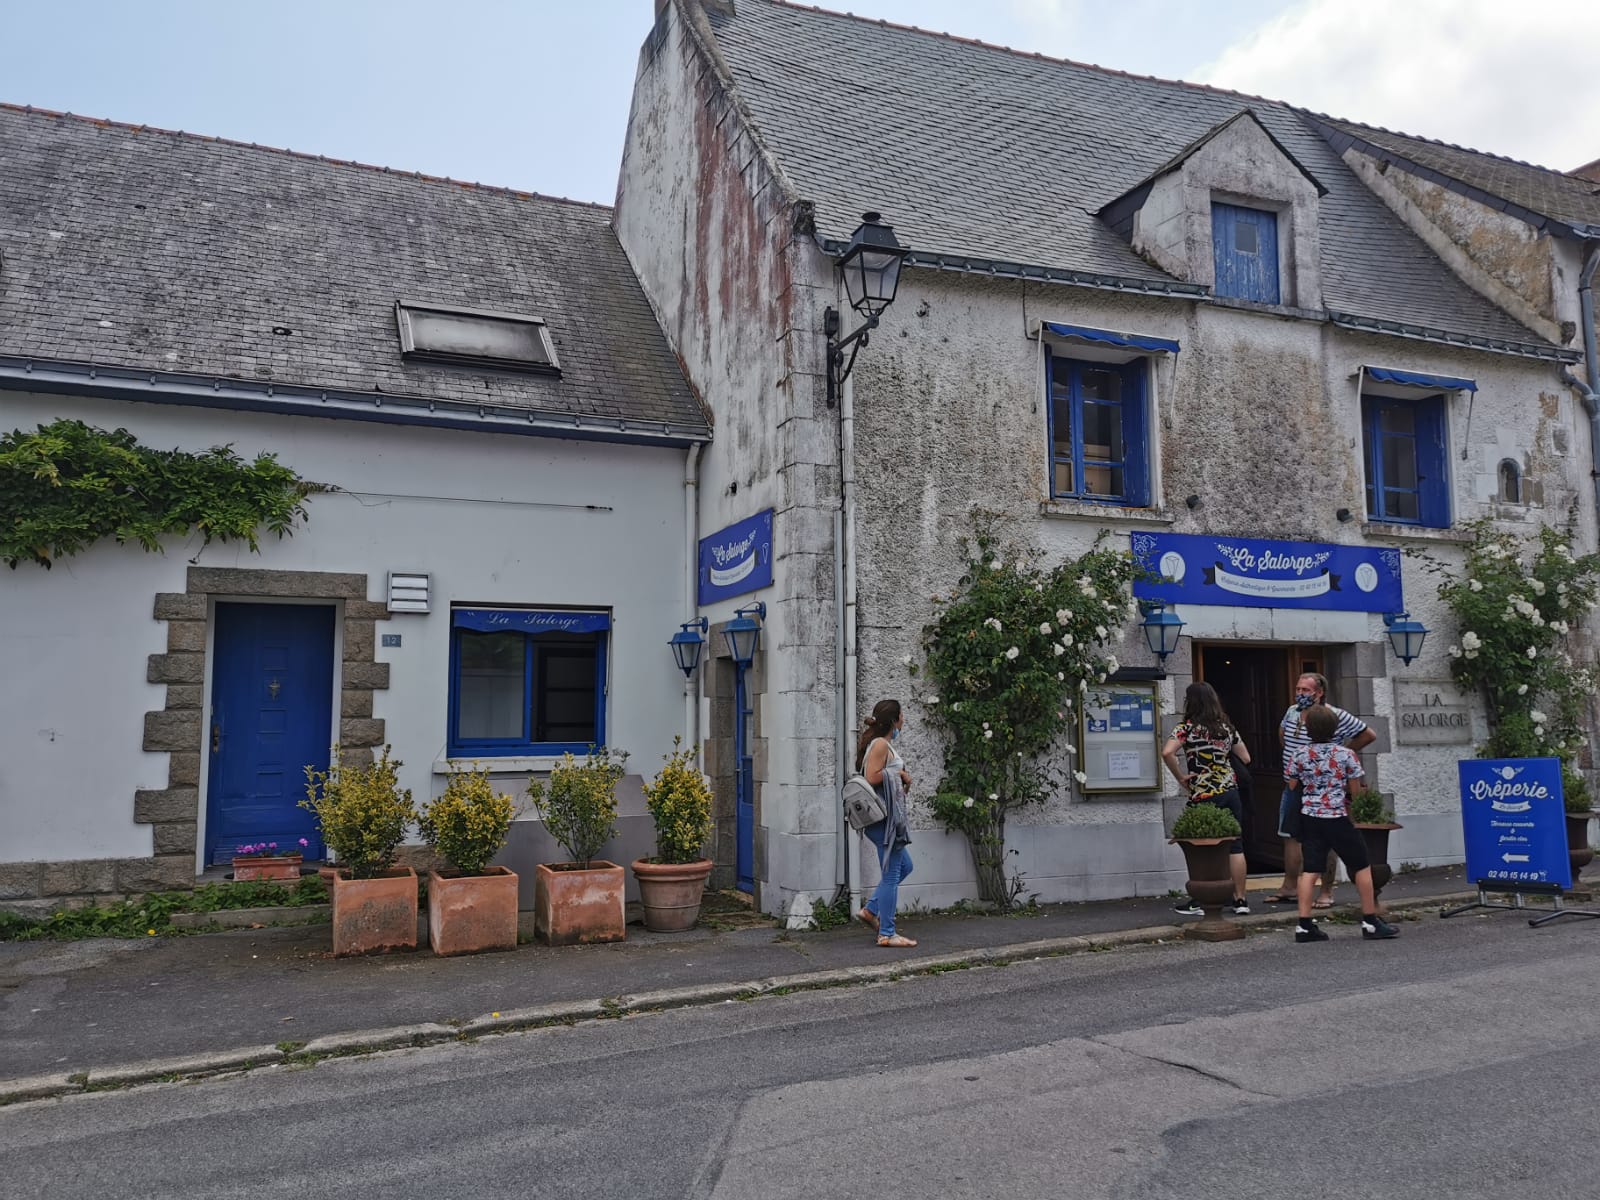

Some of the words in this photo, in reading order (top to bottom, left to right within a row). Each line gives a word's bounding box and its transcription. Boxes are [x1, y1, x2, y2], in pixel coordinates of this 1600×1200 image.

[1232, 548, 1256, 572] La
[1257, 550, 1315, 576] Salorge
[487, 611, 511, 625] La
[524, 612, 580, 631] Salorge
[1470, 780, 1548, 800] Crêperie
[1488, 870, 1498, 878] 02
[1499, 871, 1508, 879] 40
[1509, 871, 1519, 879] 15
[1519, 872, 1529, 880] 14
[1530, 872, 1539, 880] 19
